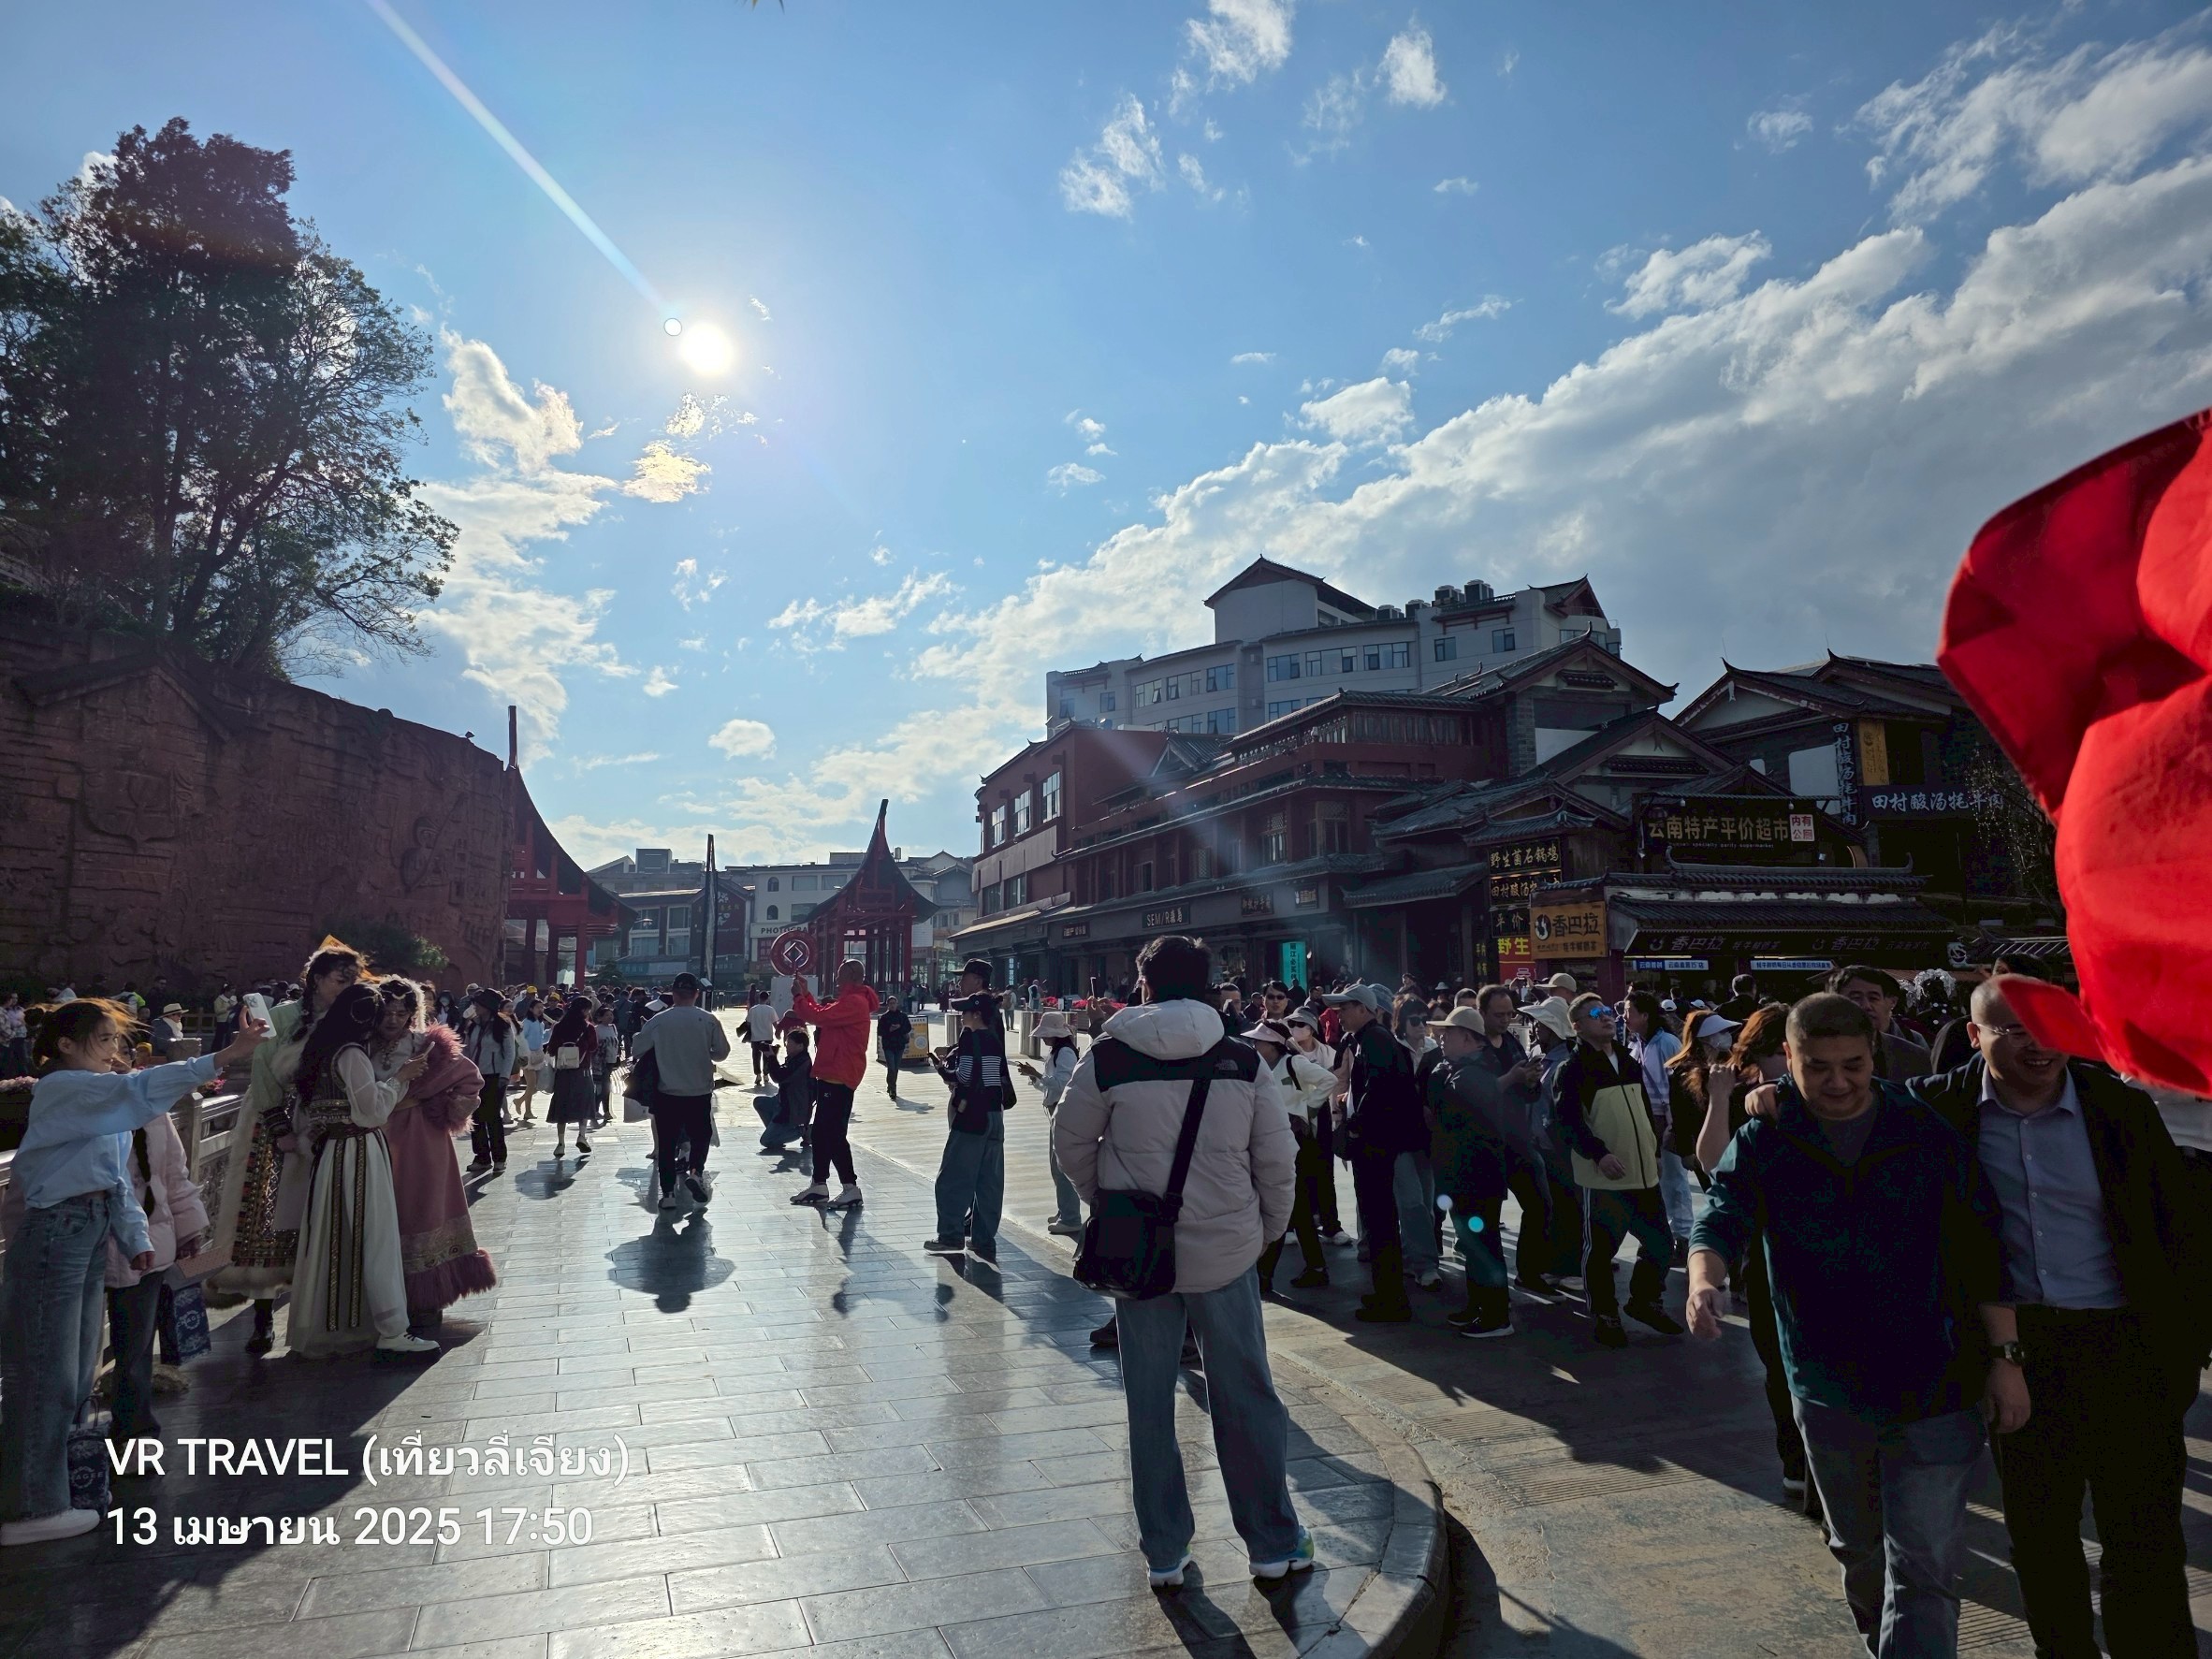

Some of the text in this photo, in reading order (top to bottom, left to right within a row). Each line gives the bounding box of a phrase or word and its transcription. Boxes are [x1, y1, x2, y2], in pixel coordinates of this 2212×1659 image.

[1871, 792, 2004, 812] 田村酸汤牦牛肉
[1648, 816, 1790, 840] 云南特产平价超市
[1791, 816, 1812, 827] 内有
[1793, 829, 1813, 840] 公厕
[1490, 844, 1559, 868] 野生菌石锅鸡
[1552, 912, 1600, 938] 香巴拉
[1497, 938, 1530, 955] 野生
[1671, 937, 1726, 951] 香巴拉
